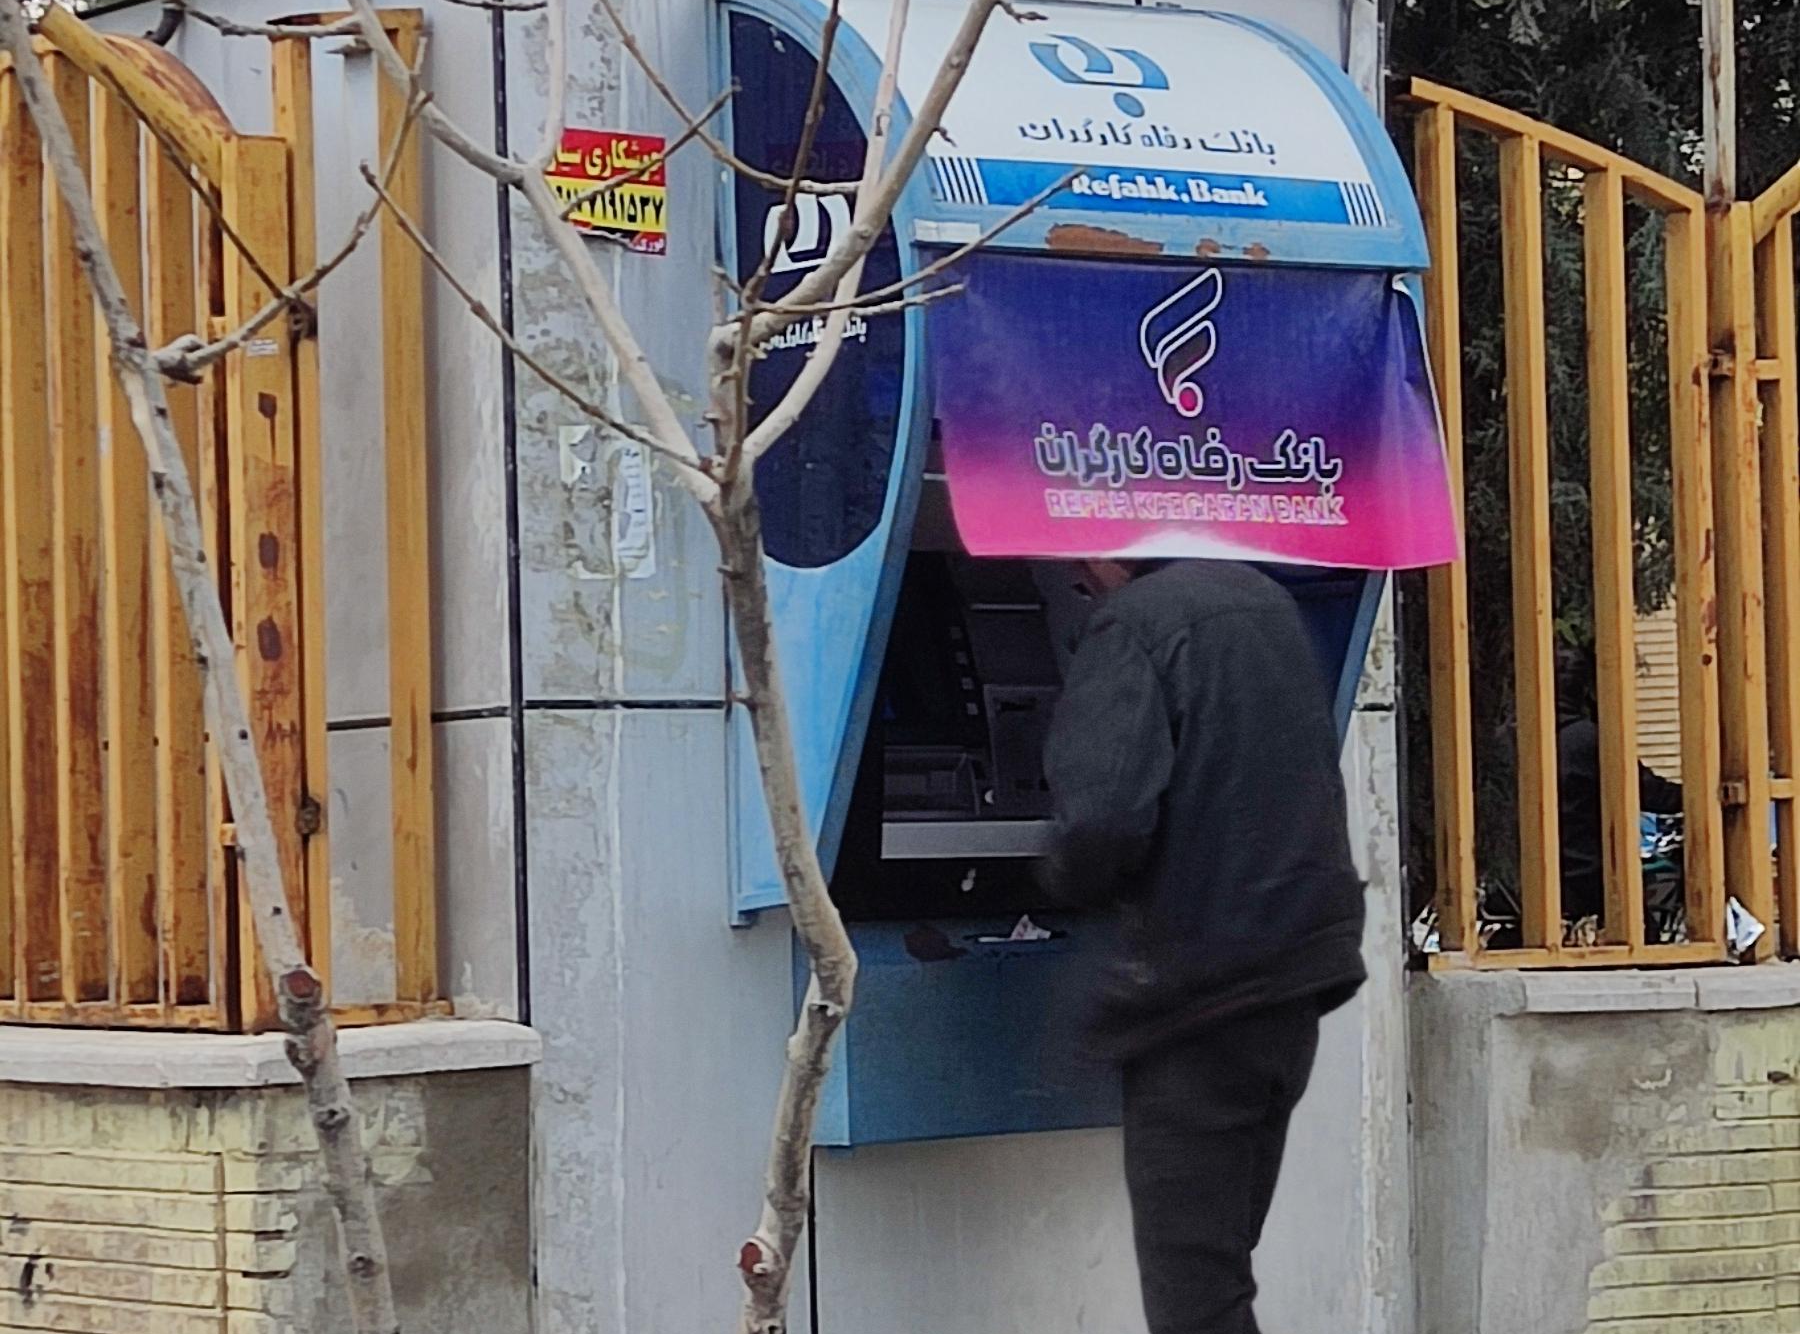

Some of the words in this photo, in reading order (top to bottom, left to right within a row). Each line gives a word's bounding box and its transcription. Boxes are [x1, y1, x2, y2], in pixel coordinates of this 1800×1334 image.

[1018, 117, 1132, 147] کارگران
[1141, 124, 1192, 150] رفاه
[1199, 130, 1277, 165] بانک
[1035, 422, 1152, 487] کارگران
[1152, 426, 1245, 491] رفاه
[1246, 428, 1342, 497] بانک
[1044, 488, 1134, 518] REFAH
[1272, 495, 1349, 526] BANK
